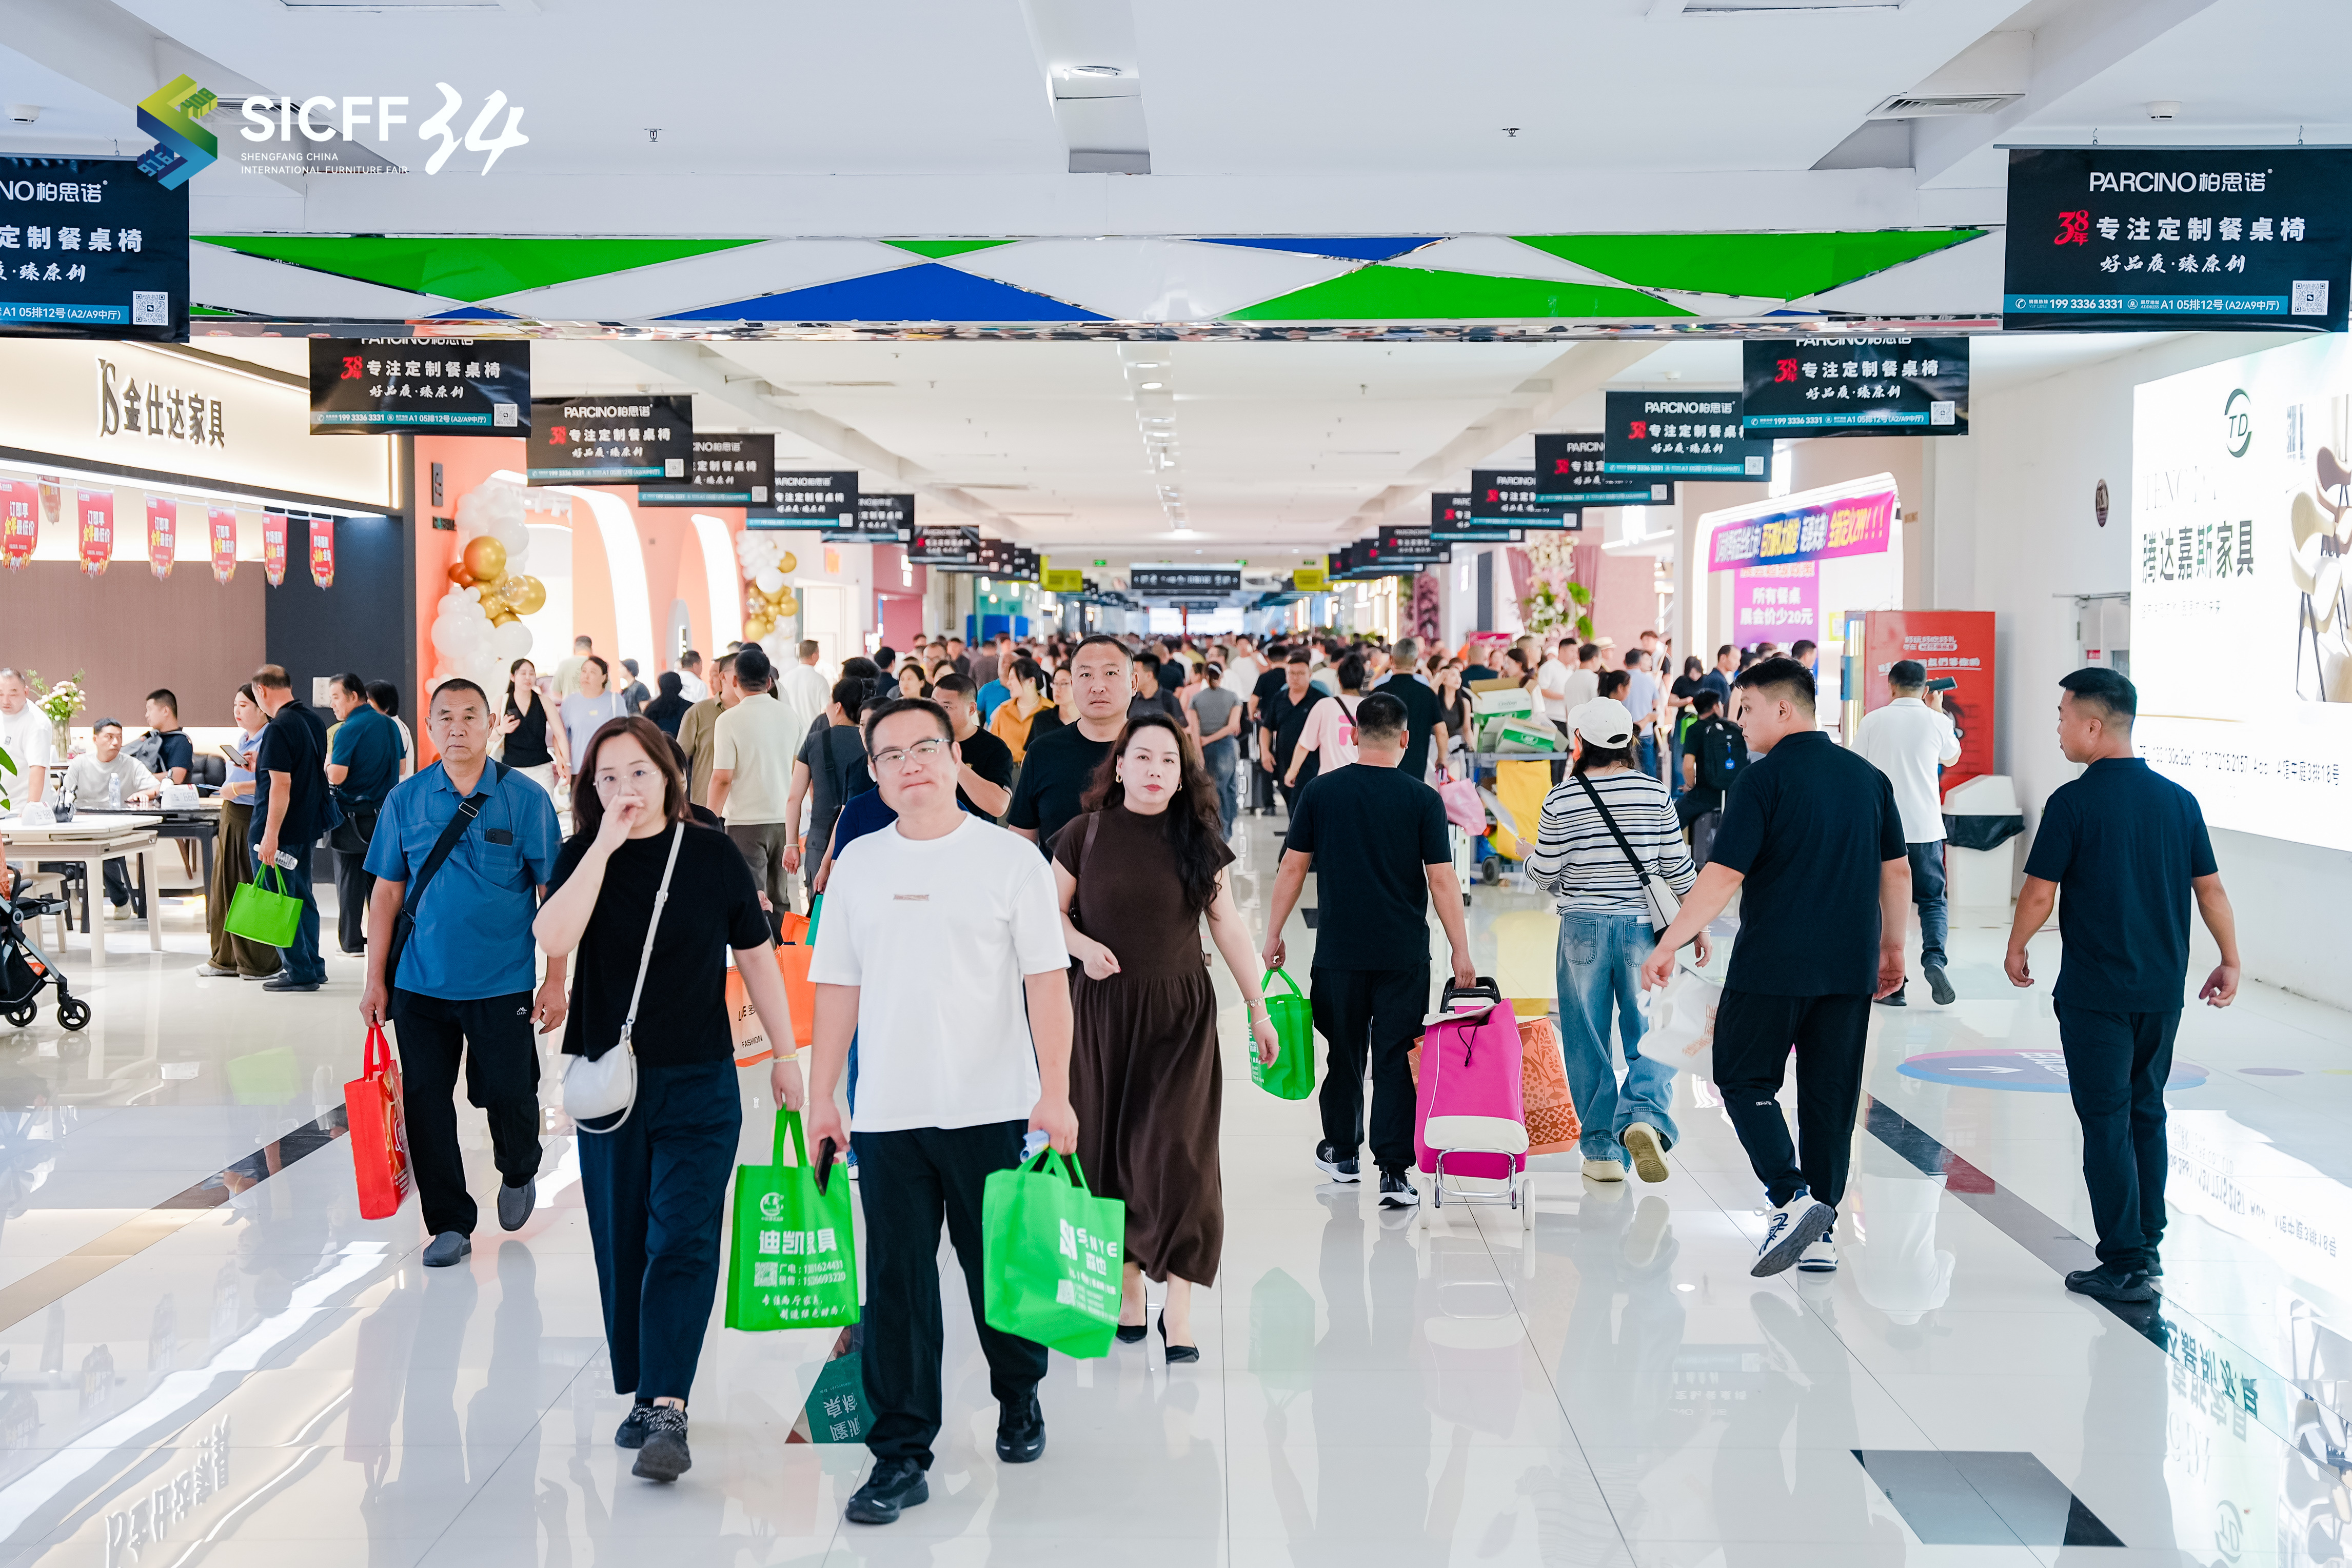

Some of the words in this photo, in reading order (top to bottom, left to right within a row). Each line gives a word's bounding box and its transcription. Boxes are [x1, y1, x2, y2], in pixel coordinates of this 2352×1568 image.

[2096, 217, 2305, 242] 专注定制餐桌椅
[0, 225, 143, 252] 定制餐桌椅
[3, 307, 16, 316] A1
[2049, 299, 2067, 309] 199
[2070, 299, 2097, 309] 3336
[2098, 299, 2123, 309] 3331
[2160, 300, 2173, 309] A1
[366, 360, 500, 379] 专注定制餐桌椅
[1802, 360, 1939, 379] 专注定制餐桌椅
[123, 378, 224, 449] 金仕达家具
[1787, 416, 1805, 425] 3336
[1805, 416, 1823, 424] 3331
[2229, 413, 2248, 438] TD
[569, 427, 670, 442] 专注定制餐桌椅
[693, 460, 757, 472] 定制餐桌椅
[1496, 476, 1536, 486] PARCINO
[2142, 520, 2254, 584] 腾达嘉斯家具
[742, 1035, 763, 1048] FASHION
